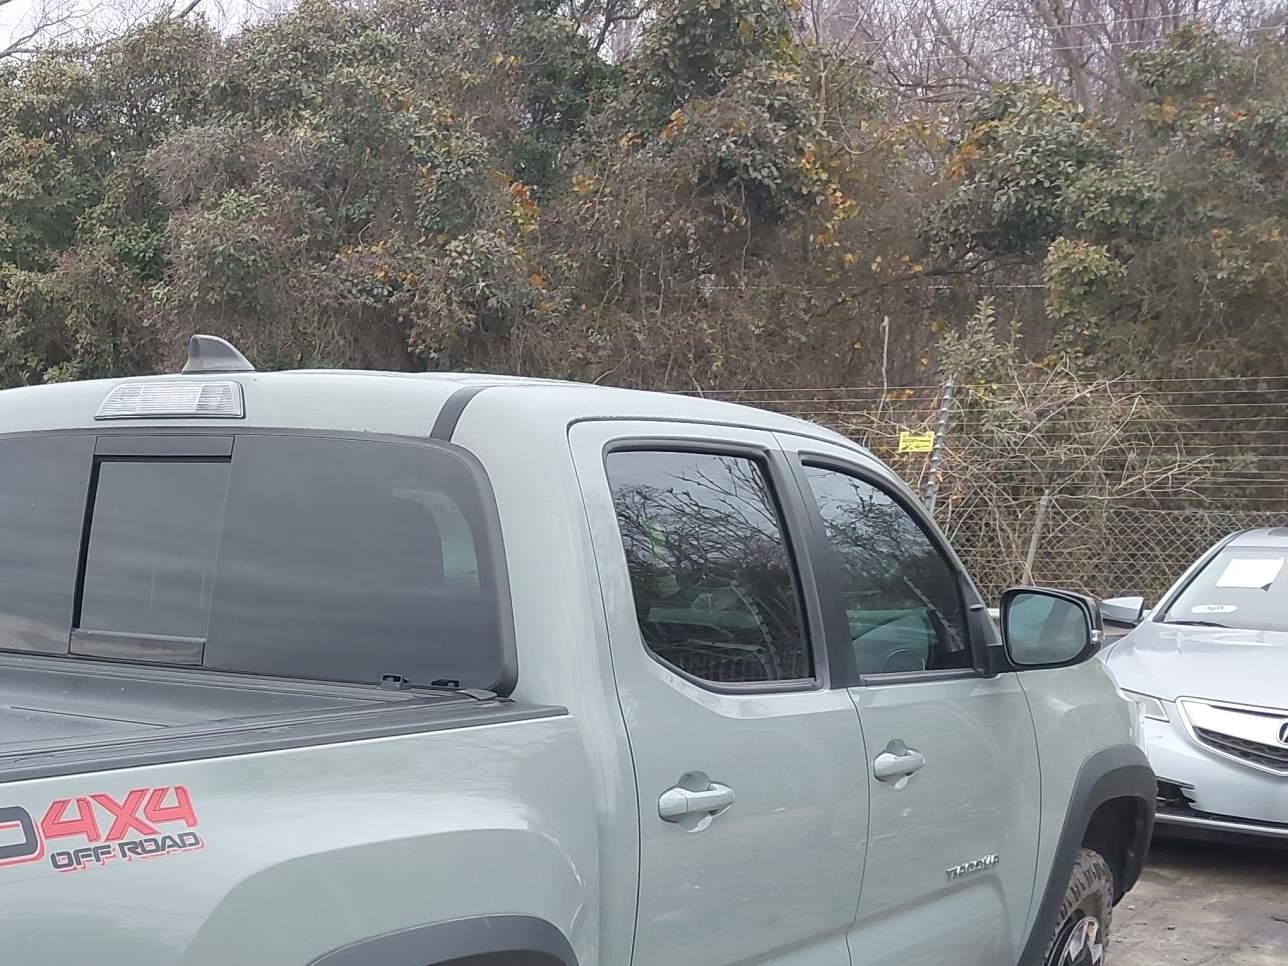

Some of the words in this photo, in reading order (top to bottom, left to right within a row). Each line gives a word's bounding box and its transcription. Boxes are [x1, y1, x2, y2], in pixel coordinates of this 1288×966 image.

[40, 785, 199, 842] 4X4
[50, 844, 117, 870] OFF
[117, 831, 204, 861] ROAD
